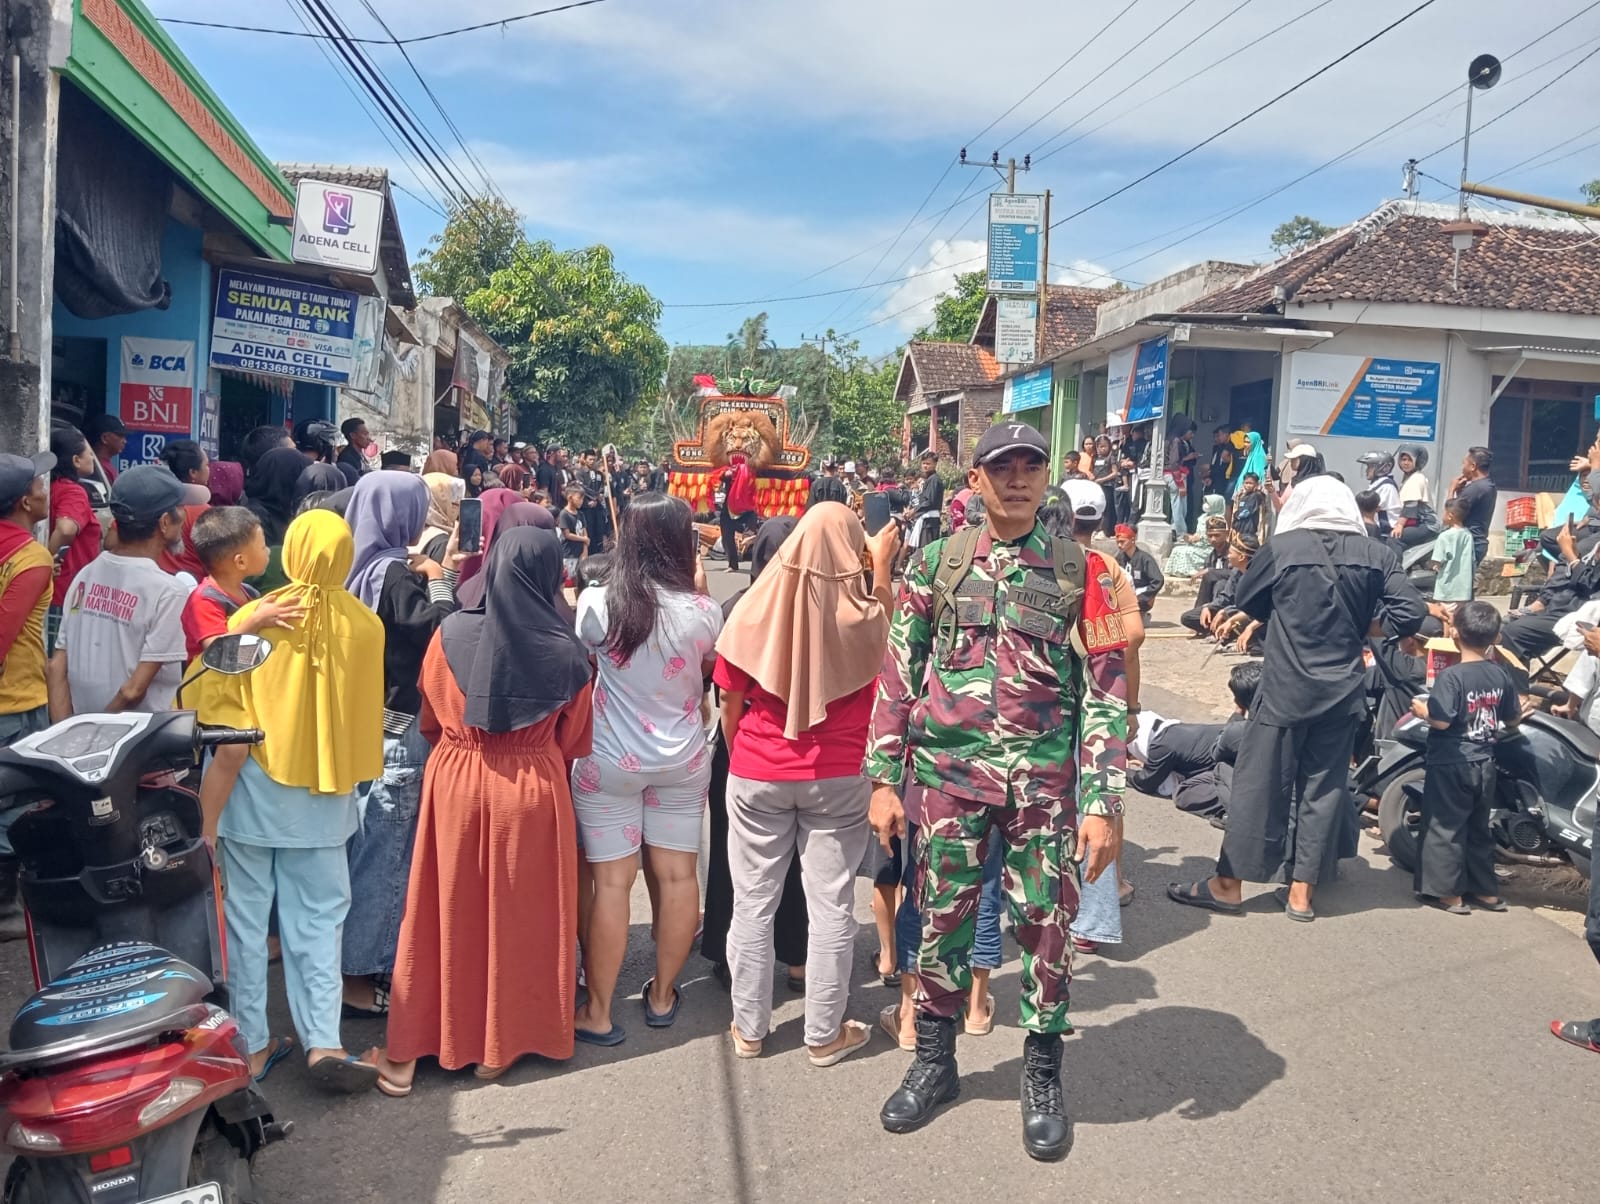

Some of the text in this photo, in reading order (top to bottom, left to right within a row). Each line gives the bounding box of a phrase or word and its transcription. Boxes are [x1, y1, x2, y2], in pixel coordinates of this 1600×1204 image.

[299, 234, 371, 254] ADENA CELL
[229, 280, 265, 293] MELAYANI
[267, 286, 300, 300] TRANSFER
[309, 293, 329, 304] TARIK
[330, 296, 351, 308] TUNAI
[227, 291, 350, 323] SEMUA BANK
[235, 308, 310, 331] PAKAI MESIN EDC
[231, 342, 332, 368] ADENA CELL
[314, 343, 333, 353] VISA
[149, 355, 185, 371] BCA
[240, 358, 322, 379] 081336851331
[134, 401, 178, 423] BNI
[1007, 424, 1025, 439] 7
[88, 583, 110, 599] JOKO
[1016, 590, 1037, 605] TNI
[92, 1175, 136, 1193] HONDA
